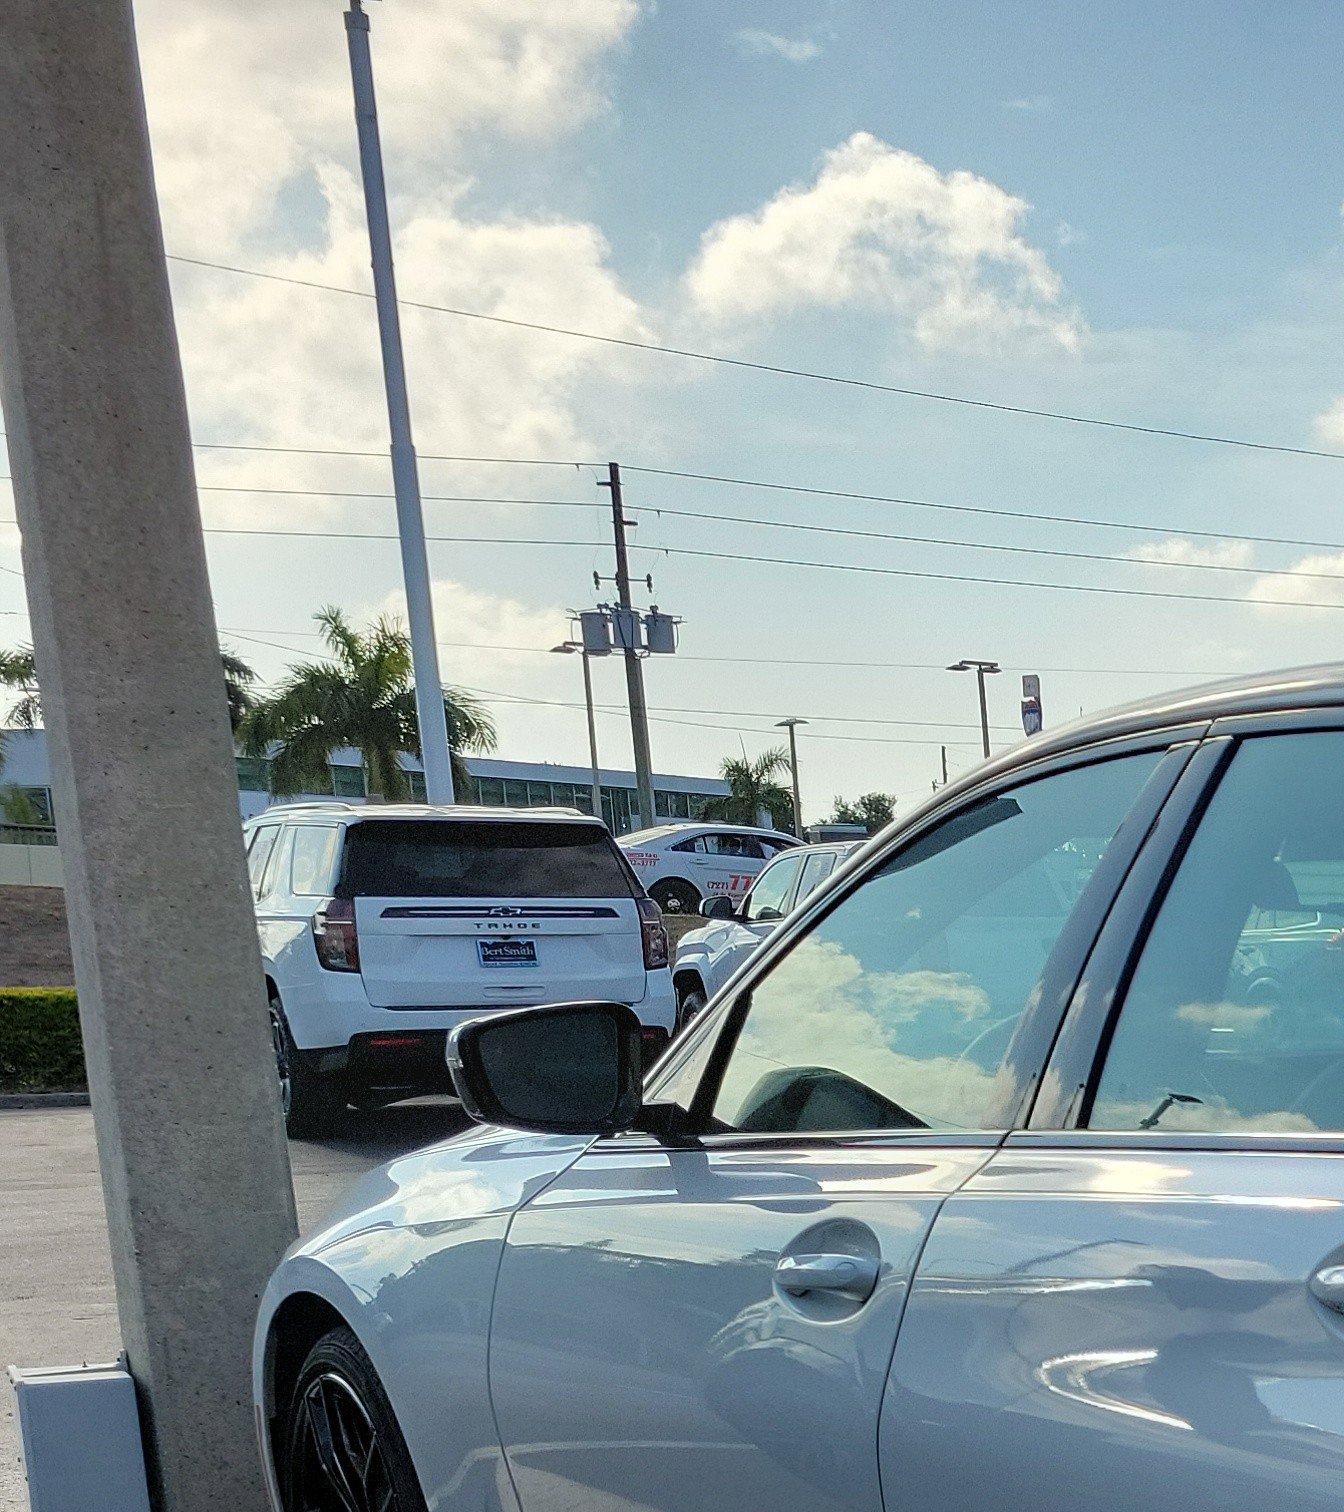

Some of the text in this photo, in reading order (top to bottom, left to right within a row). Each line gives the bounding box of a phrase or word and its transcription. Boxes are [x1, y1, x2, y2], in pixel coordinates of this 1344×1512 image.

[473, 922, 541, 930] TAHOE
[482, 946, 534, 956] Bert Smith
